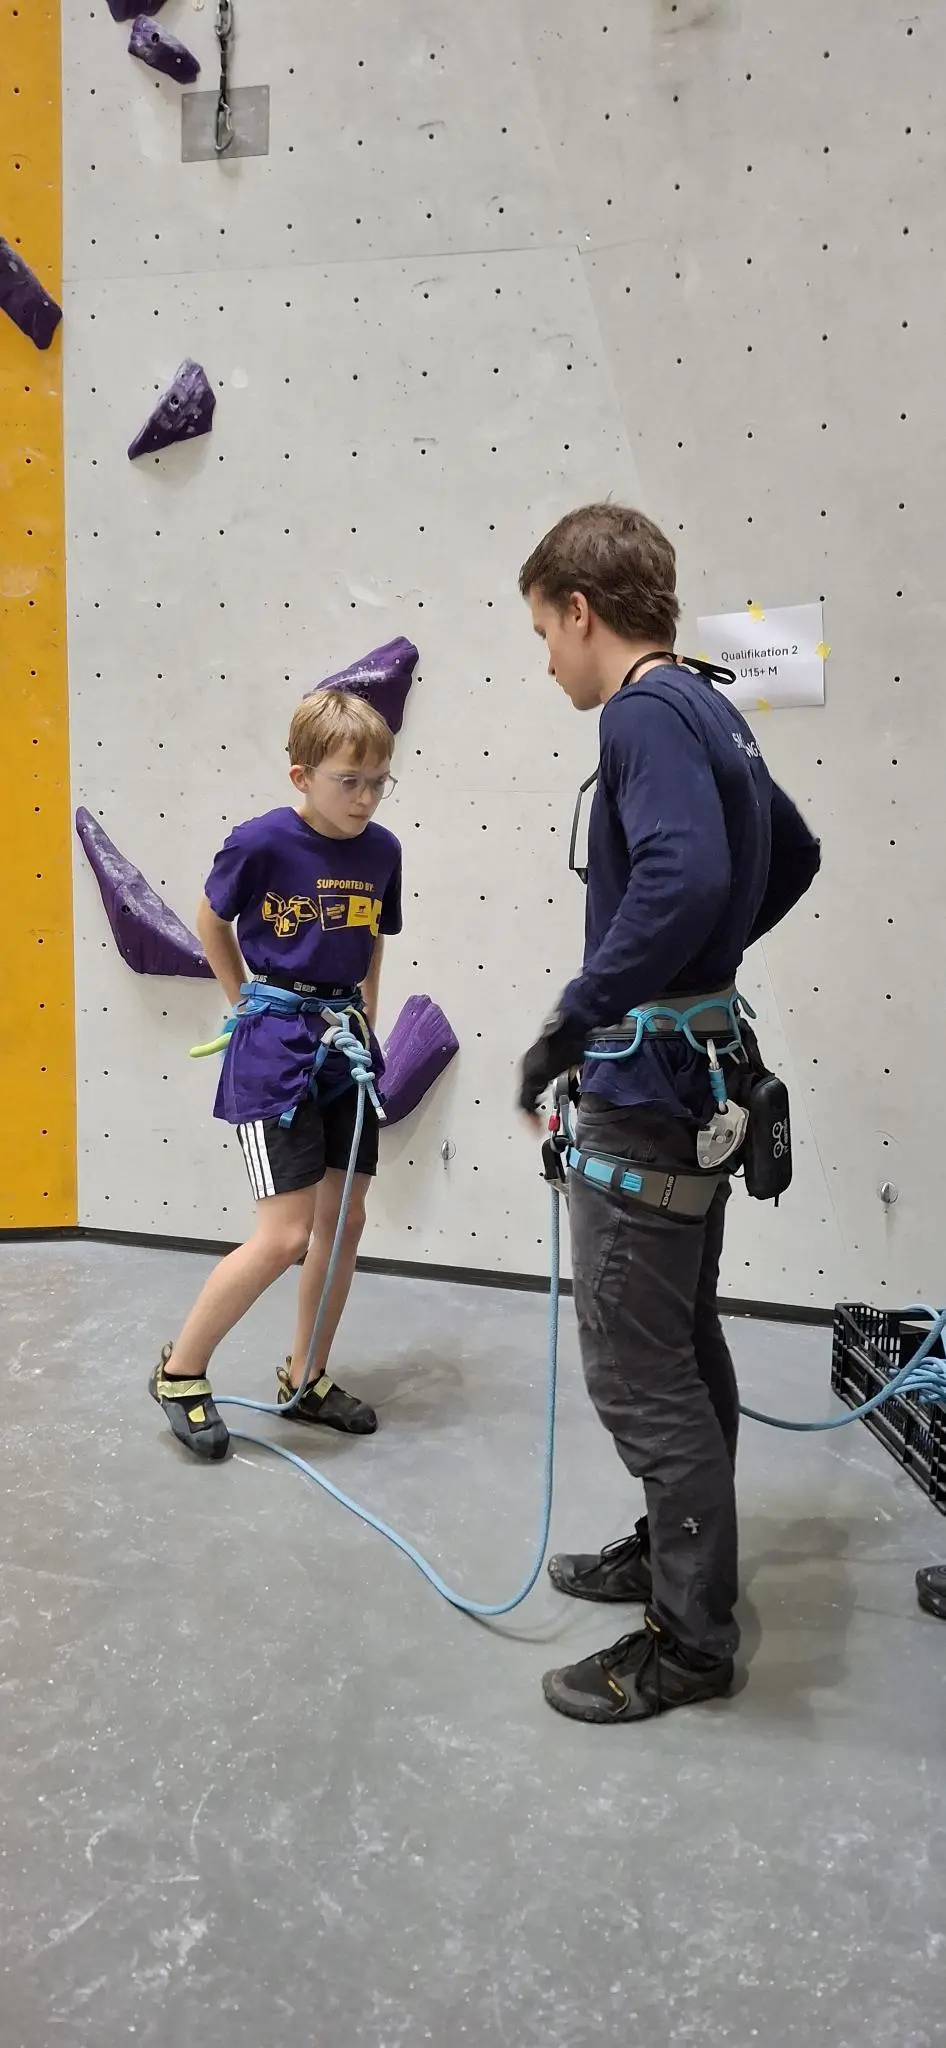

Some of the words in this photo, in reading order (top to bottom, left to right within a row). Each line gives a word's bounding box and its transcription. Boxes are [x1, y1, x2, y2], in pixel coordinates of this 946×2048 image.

[721, 646, 789, 662] Qualifikation
[791, 645, 798, 655] 2
[740, 667, 766, 678] U15+
[768, 666, 778, 676] M
[316, 879, 364, 890] SUPPORTED
